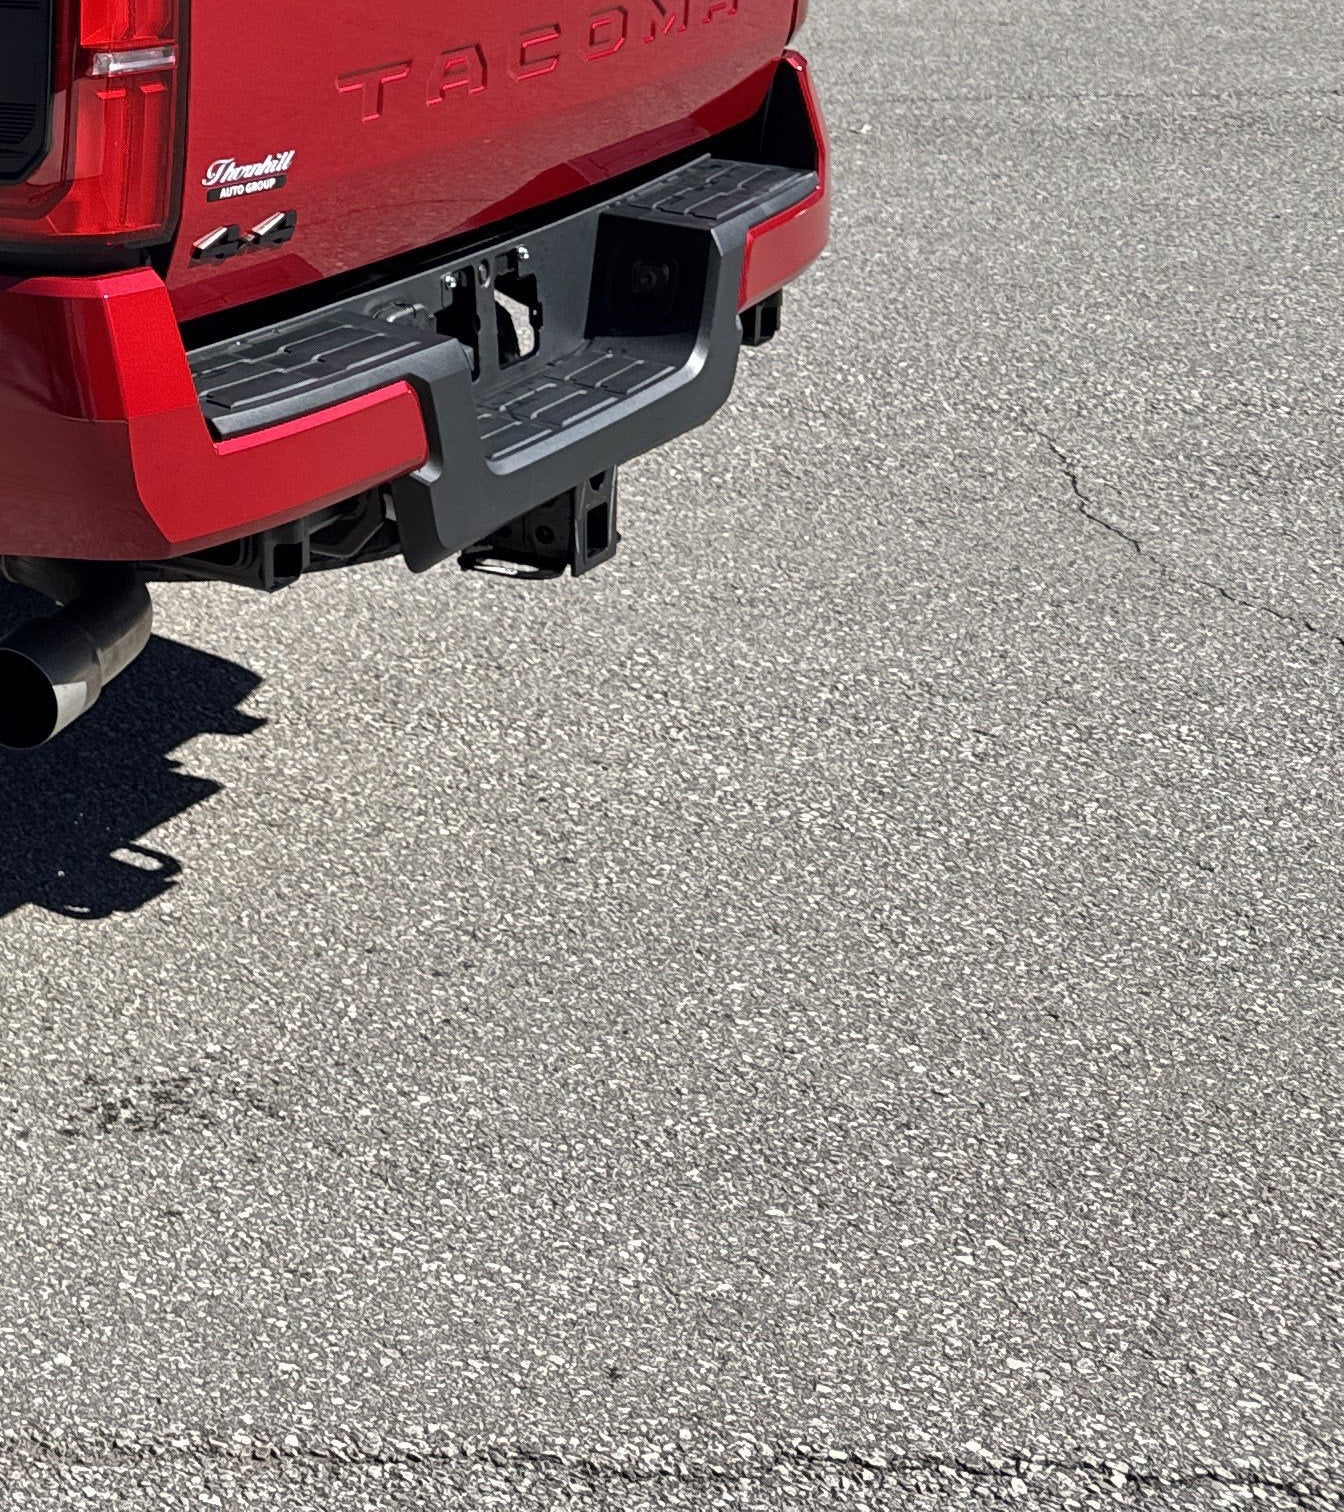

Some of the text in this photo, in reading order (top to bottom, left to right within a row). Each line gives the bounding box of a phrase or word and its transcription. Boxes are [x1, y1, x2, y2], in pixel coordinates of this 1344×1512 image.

[201, 150, 295, 186] Thornhill
[219, 178, 276, 199] AUTO GROUP
